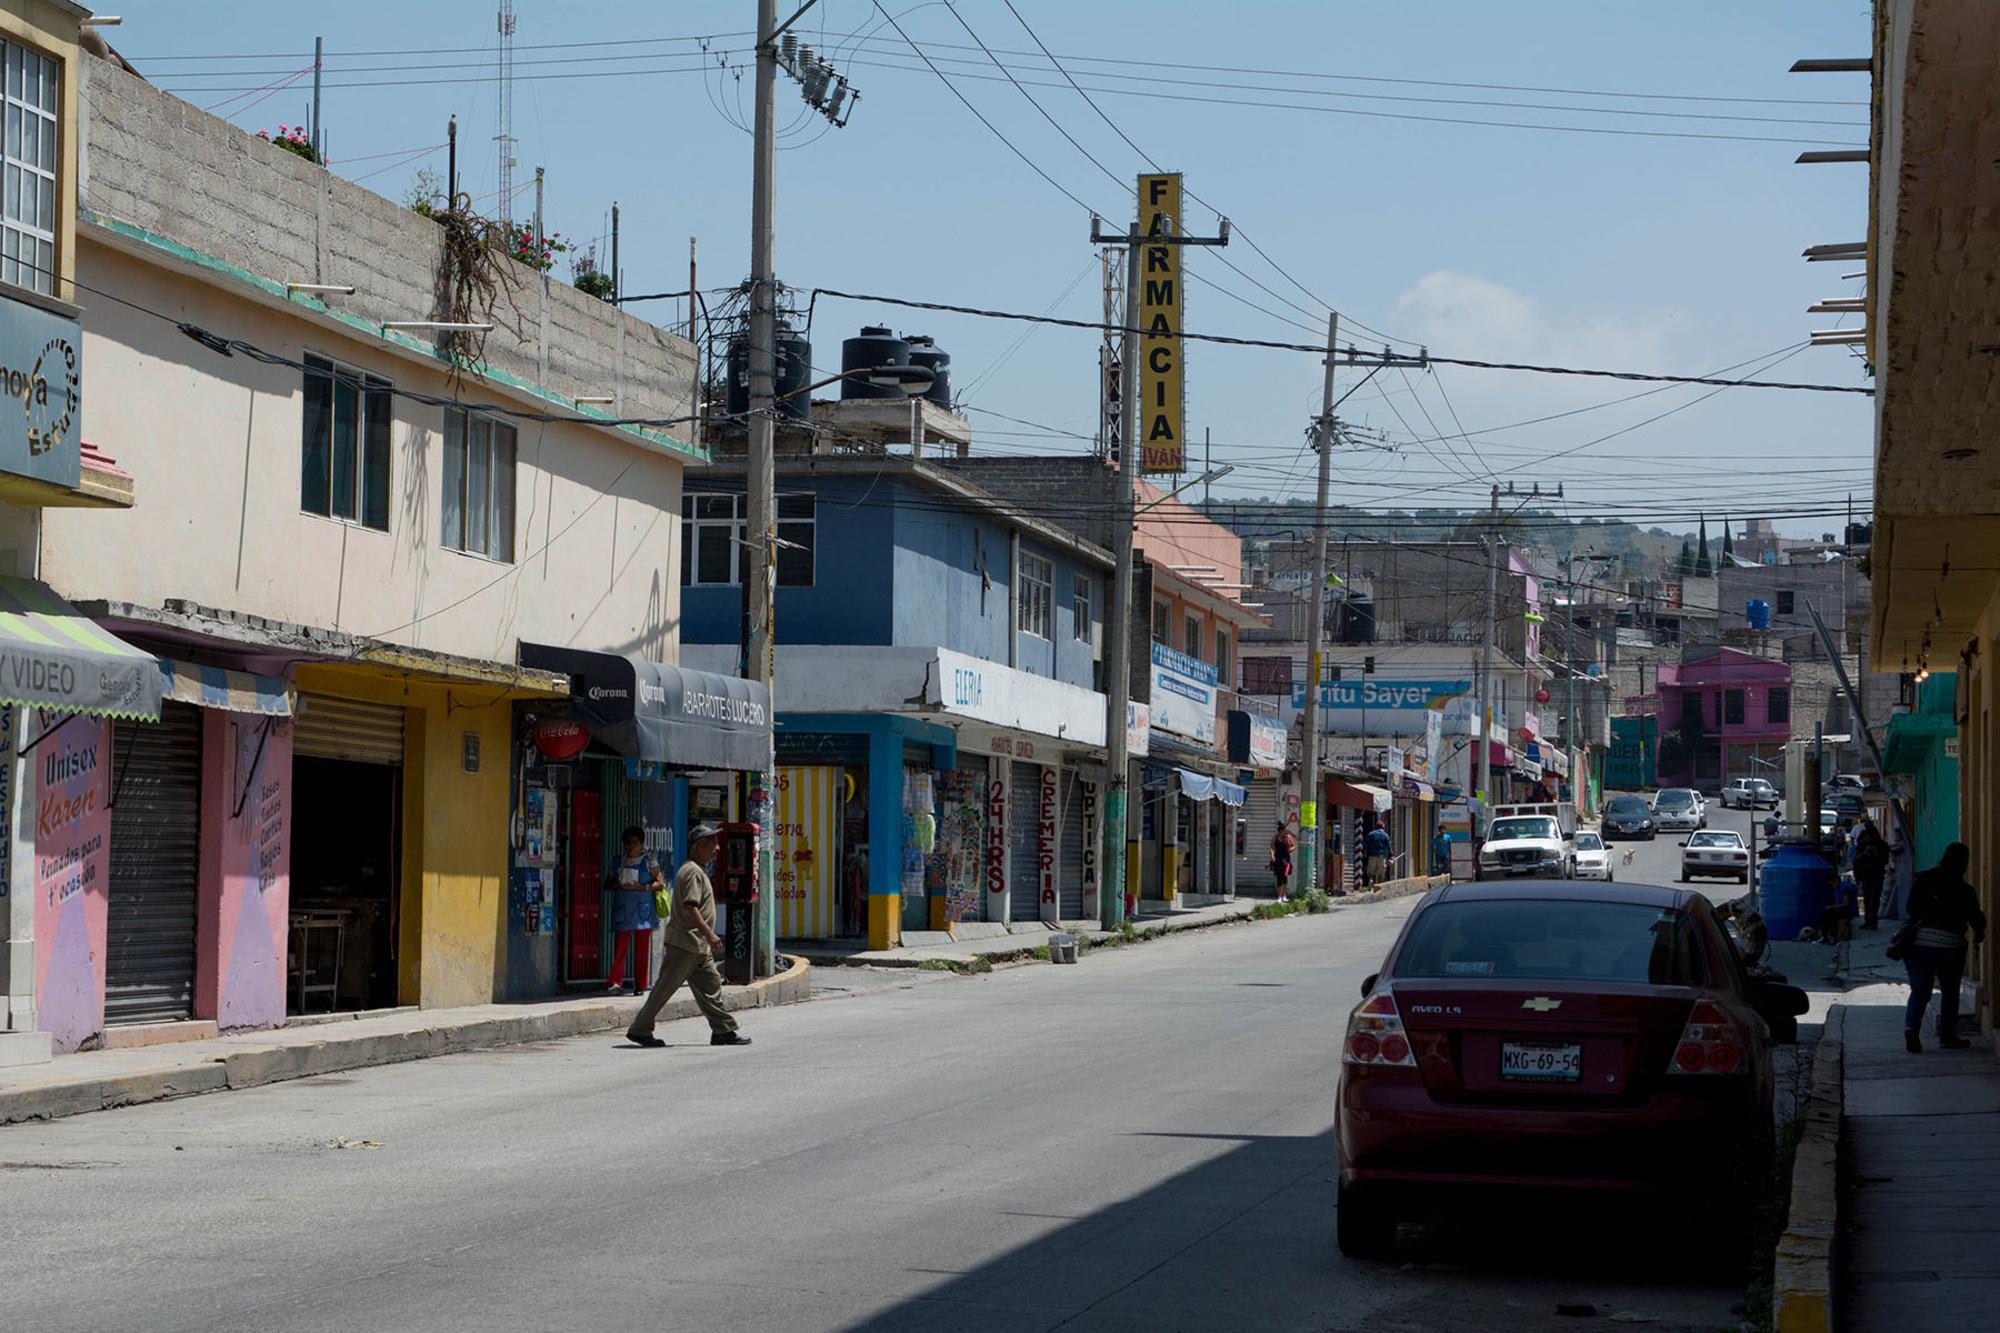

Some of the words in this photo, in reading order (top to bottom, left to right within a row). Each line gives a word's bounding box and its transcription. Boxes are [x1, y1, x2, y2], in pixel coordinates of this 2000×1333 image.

[1146, 180, 1174, 440] FARMACIA
[11, 656, 75, 695] VIDEO
[588, 686, 627, 700] Corona
[682, 690, 731, 721] ABARROTES
[732, 698, 765, 727] LUCERO
[1293, 683, 1354, 704] Pntu
[1361, 682, 1431, 709] Sayer
[45, 744, 97, 787] Unisex
[39, 788, 96, 838] Karen
[81, 834, 102, 862] para
[1039, 770, 1057, 903] CREMERIA
[1411, 1005, 1442, 1014] AVEO
[1504, 1052, 1579, 1071] MXG-69-54
